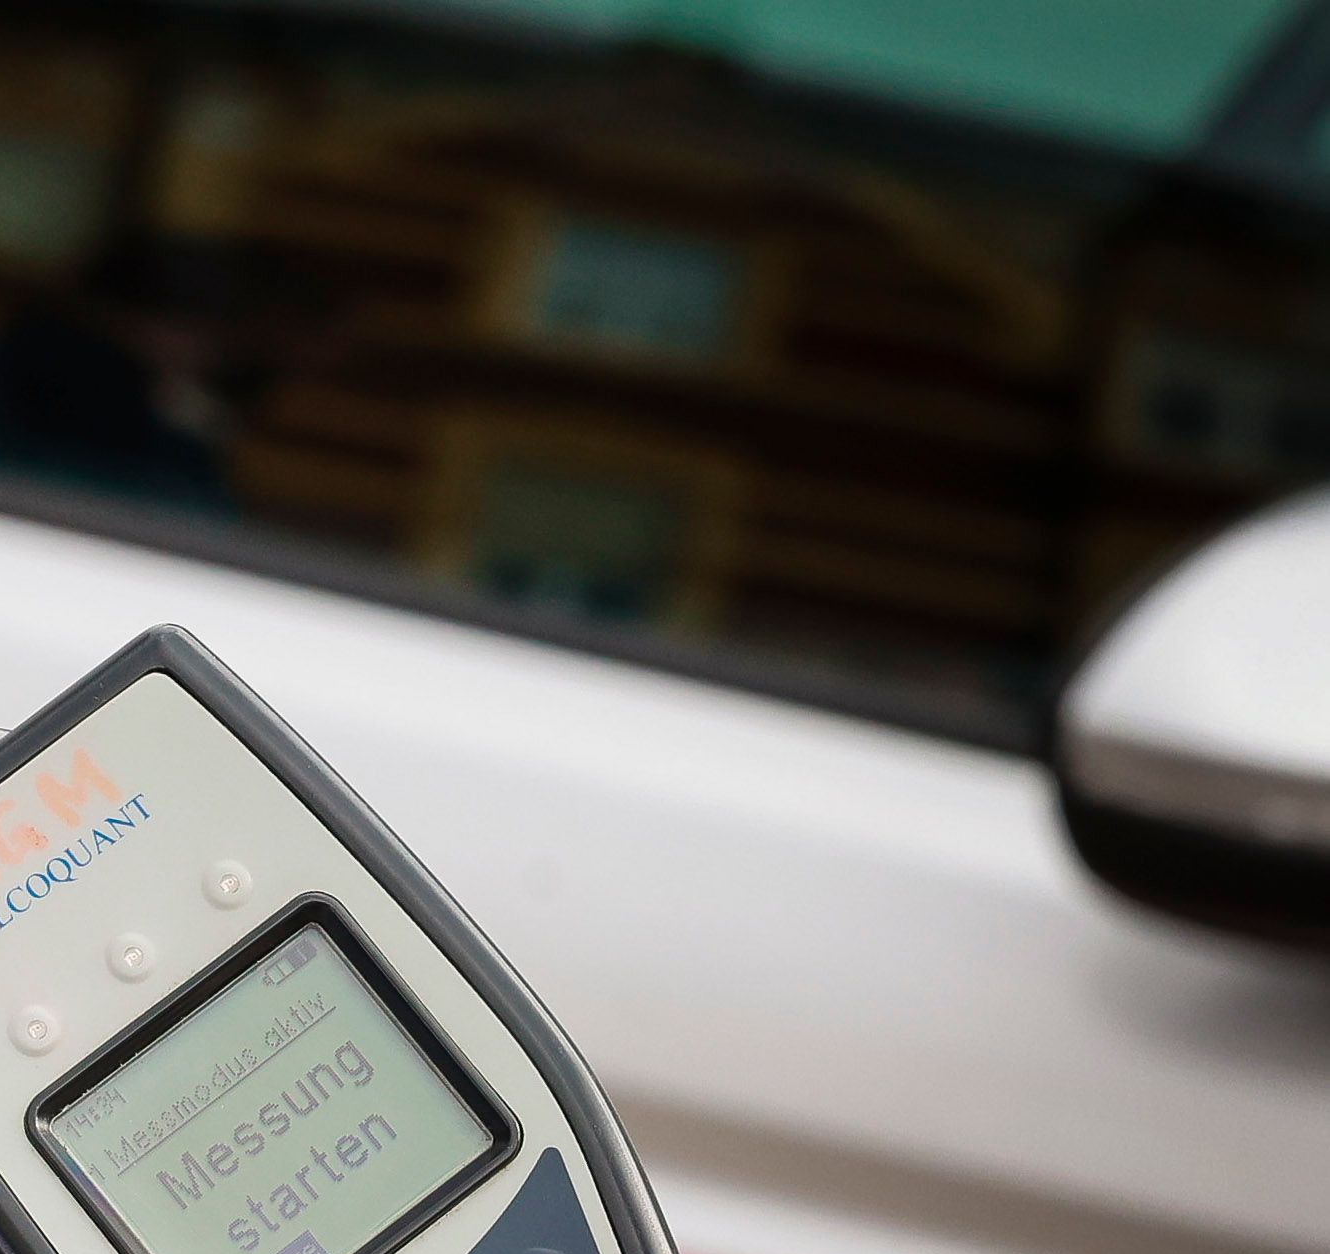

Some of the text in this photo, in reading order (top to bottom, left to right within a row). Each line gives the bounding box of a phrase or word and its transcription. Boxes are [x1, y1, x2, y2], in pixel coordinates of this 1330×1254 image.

[103, 1048, 258, 1170] Messmodus
[264, 992, 325, 1049] aktiv
[155, 1040, 375, 1211] Messung
[227, 1114, 398, 1252] starten
